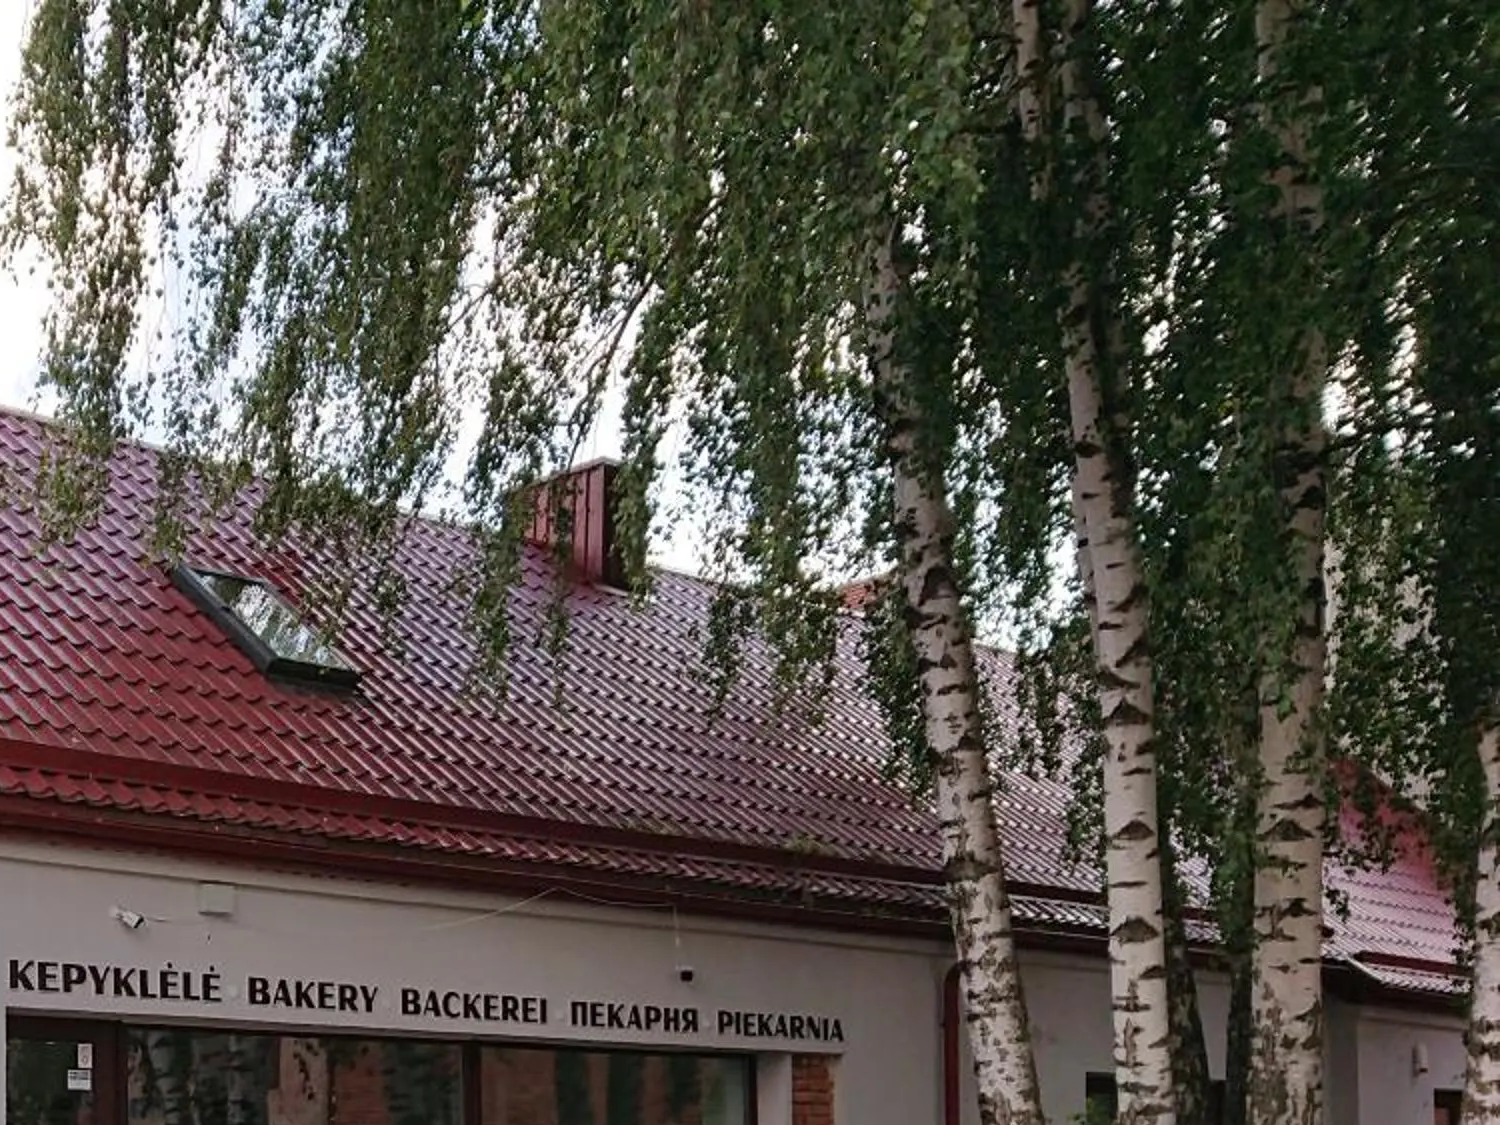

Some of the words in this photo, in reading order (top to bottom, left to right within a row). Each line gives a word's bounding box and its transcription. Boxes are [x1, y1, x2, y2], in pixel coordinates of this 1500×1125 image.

[8, 959, 222, 1003] KEPYKLĖLĖ
[247, 976, 379, 1013] BAKERY
[401, 988, 548, 1025] BACKEREI
[569, 1000, 699, 1033] ПЕКАРНЯ
[716, 1010, 845, 1042] PIEKARNIA
